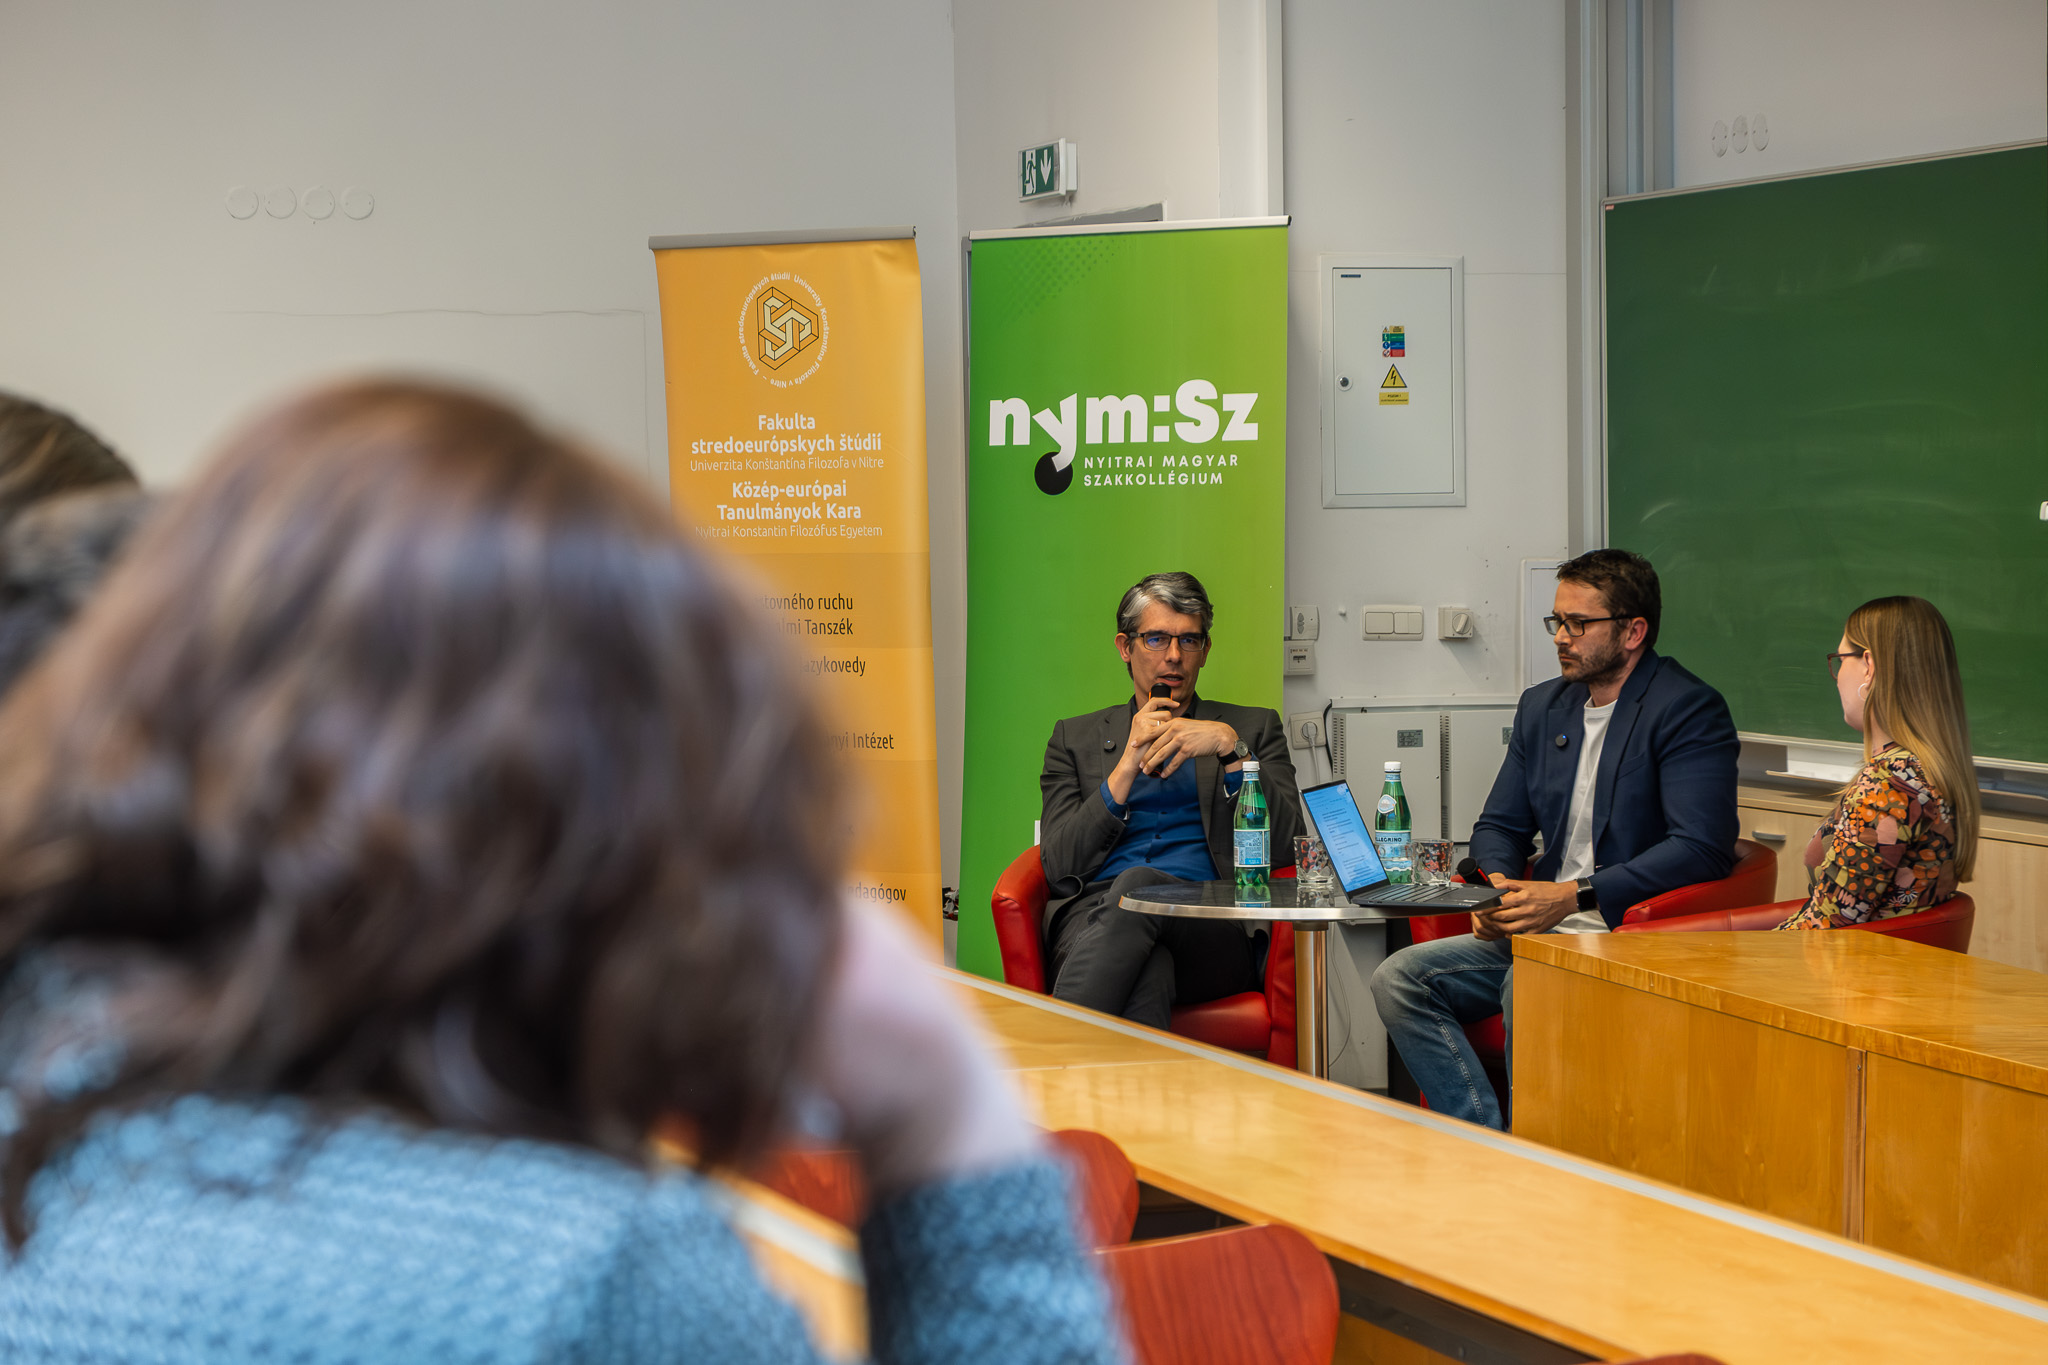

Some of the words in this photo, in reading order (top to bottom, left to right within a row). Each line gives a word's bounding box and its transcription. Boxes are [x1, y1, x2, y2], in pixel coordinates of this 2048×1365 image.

[741, 345, 760, 375] Fakulta
[758, 412, 816, 431] Fakulta
[691, 434, 835, 456] stredoeurópskych
[839, 432, 881, 451] štúdií
[690, 459, 743, 472] Univerzita
[745, 457, 806, 470] Konštantína
[808, 456, 850, 469] Filozofa
[851, 460, 857, 469] v
[858, 455, 884, 468] Nitre
[1084, 455, 1153, 469] NYITRAI
[1162, 454, 1239, 468] MAGYAR
[1083, 470, 1224, 487] SZAKKOLLÉGIUM
[732, 479, 847, 501] Közép-európai
[716, 502, 822, 523] Tanulmányok
[826, 502, 862, 519] Kara
[695, 525, 730, 538] Nyitrai
[732, 525, 788, 537] Konstantin
[790, 524, 838, 537] Filozófus
[839, 524, 883, 539] Egyetem
[762, 592, 814, 610] tovného
[818, 593, 853, 610] ruchu
[804, 618, 854, 635] Tanszék
[802, 656, 866, 677] azykovedy
[852, 732, 895, 750] Intézet
